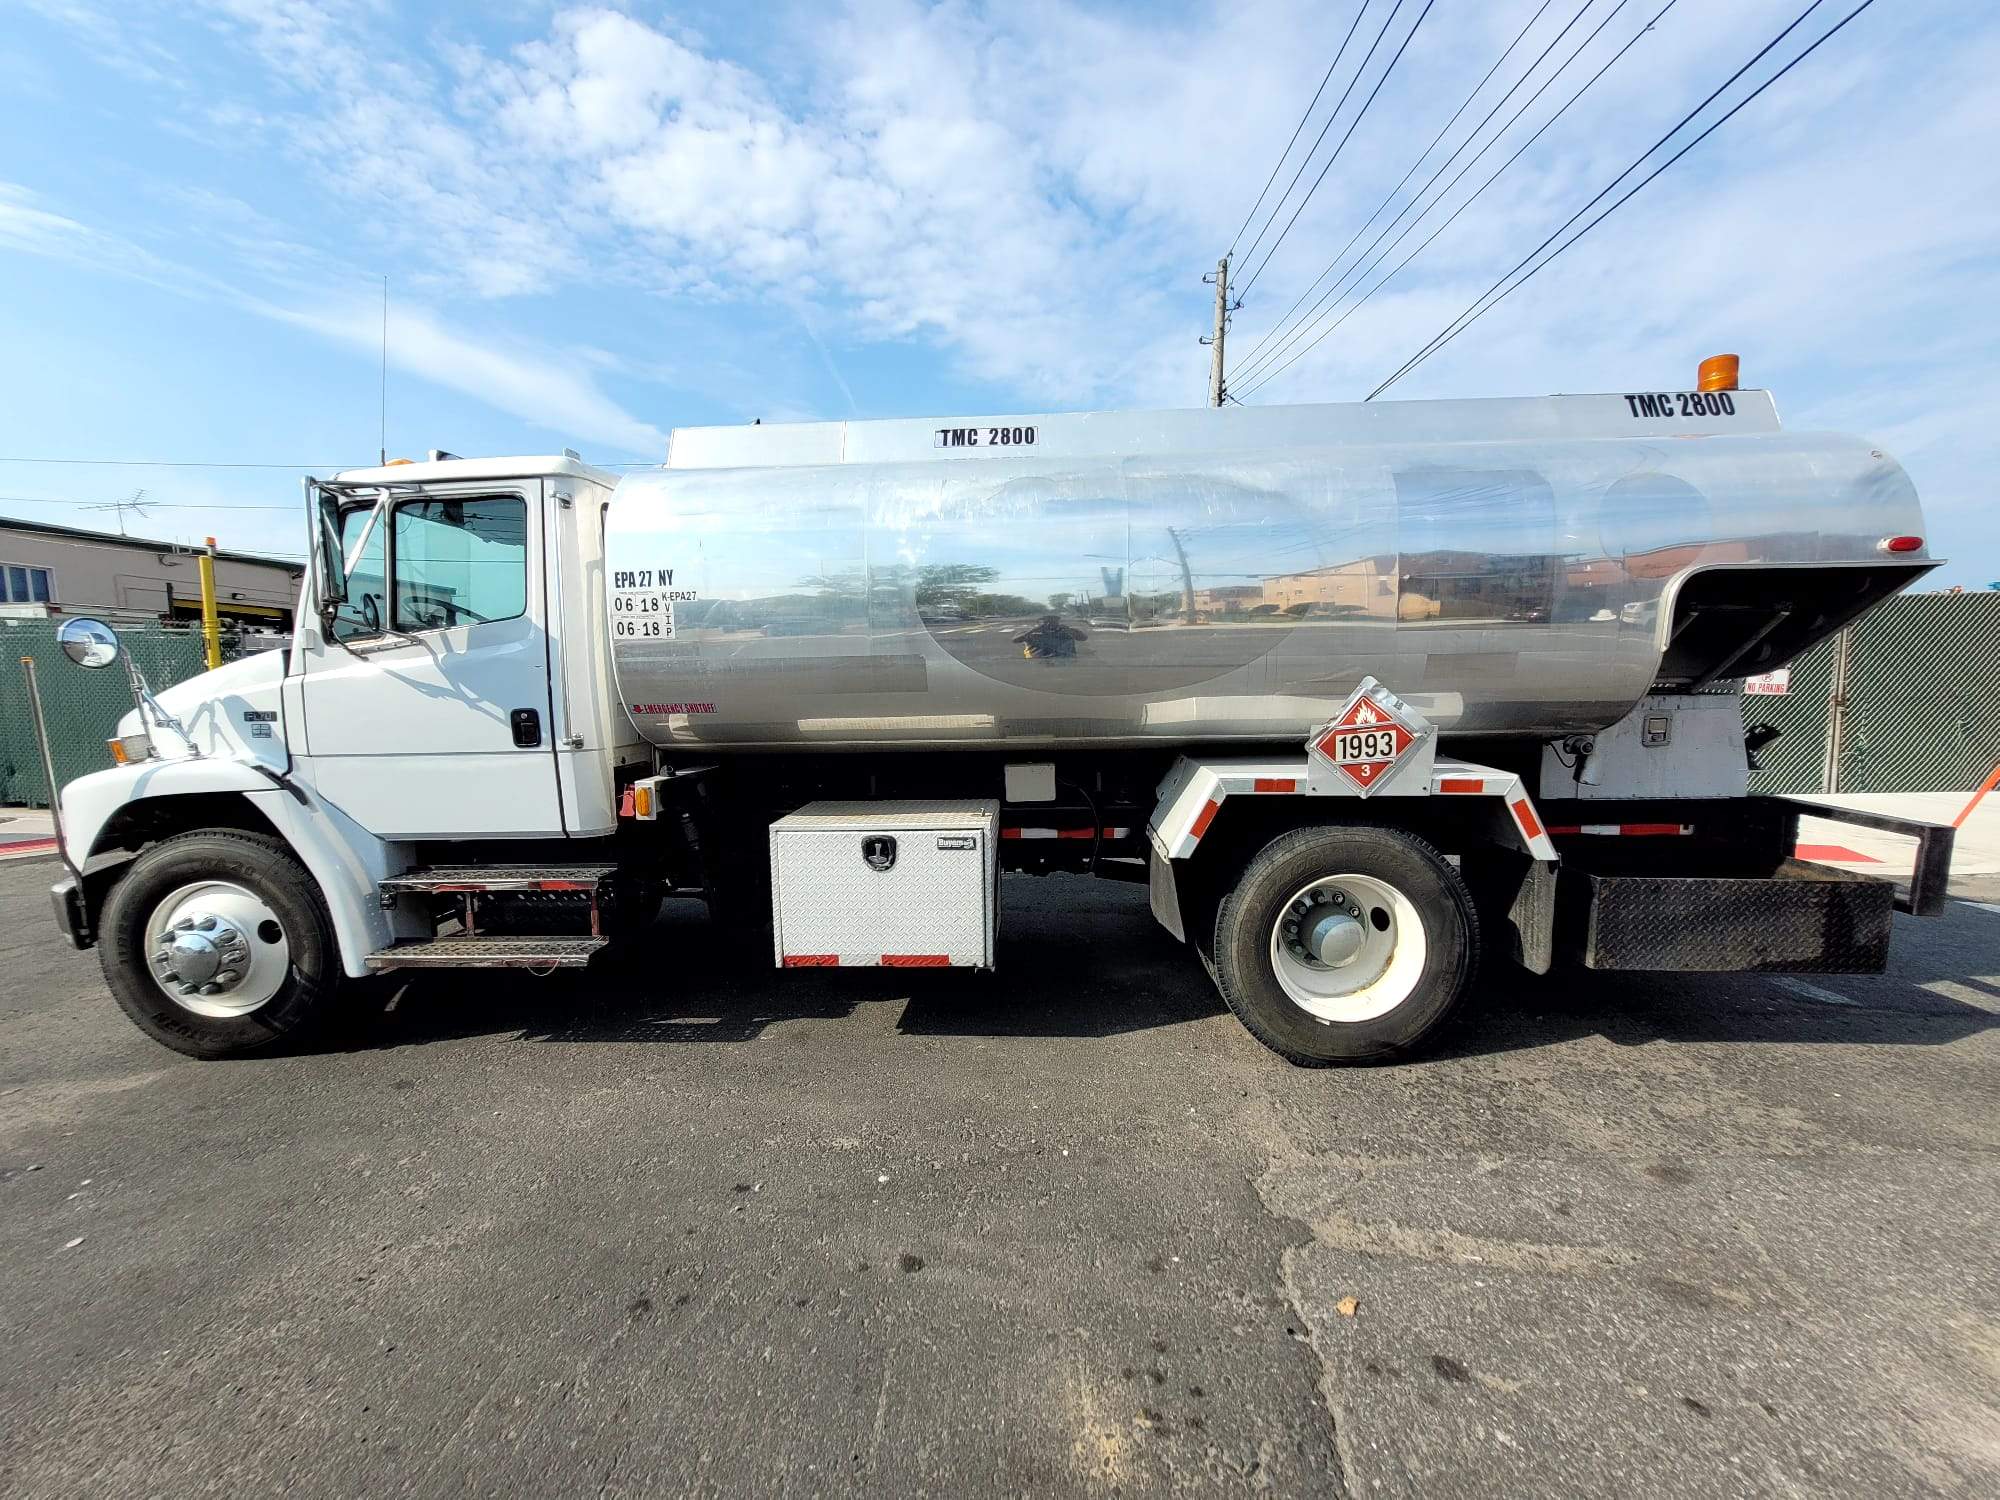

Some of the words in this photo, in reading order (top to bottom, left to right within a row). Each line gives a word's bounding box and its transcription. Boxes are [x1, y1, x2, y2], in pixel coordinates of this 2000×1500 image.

[1624, 393, 1674, 418] TMC
[1676, 392, 1736, 417] 2800
[940, 428, 978, 447] TMC
[989, 426, 1035, 446] 2800
[614, 571, 636, 588] EPA
[639, 570, 652, 587] 27
[659, 569, 673, 586] NY
[661, 591, 697, 602] K-EPA27
[614, 597, 659, 613] 06-18
[616, 621, 660, 637] 06-18
[1746, 682, 1756, 692] NO
[1757, 683, 1785, 693] PARKING
[644, 703, 683, 714] EMERGENCY
[1338, 732, 1393, 760] 1993
[1361, 764, 1371, 777] 3
